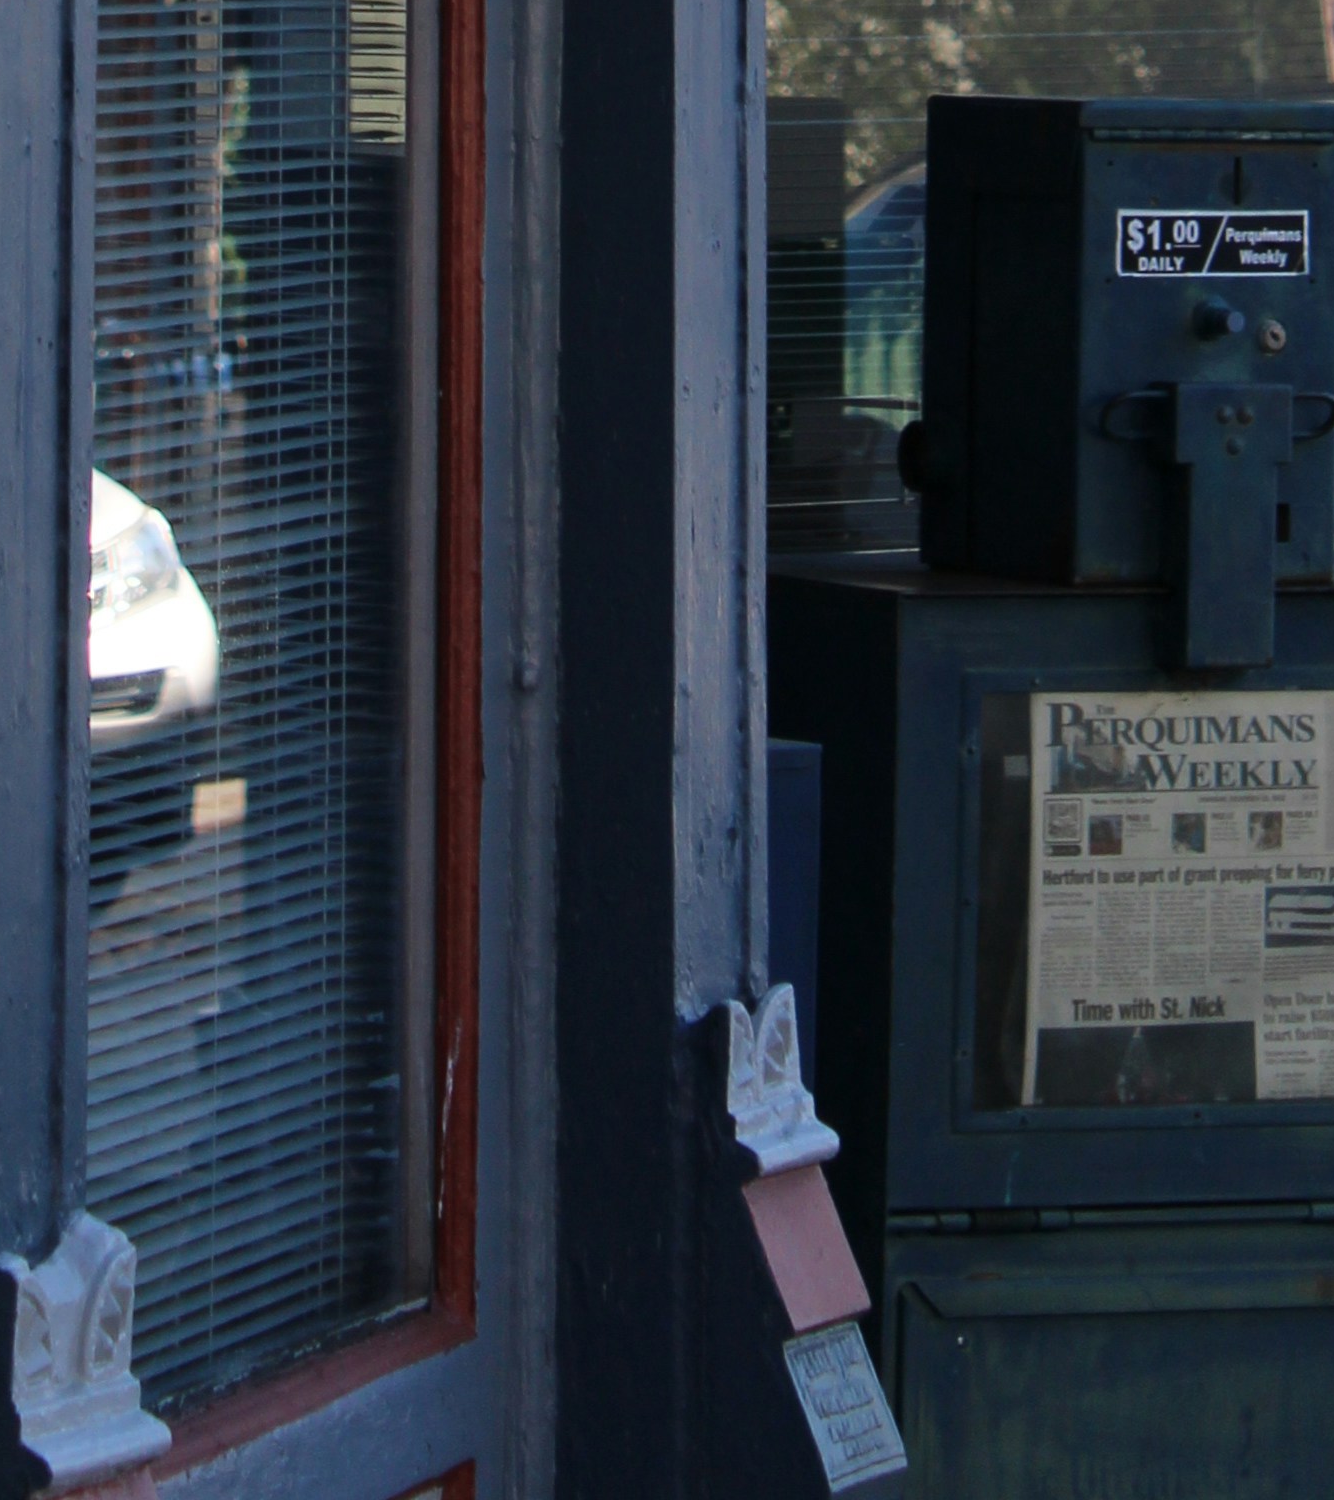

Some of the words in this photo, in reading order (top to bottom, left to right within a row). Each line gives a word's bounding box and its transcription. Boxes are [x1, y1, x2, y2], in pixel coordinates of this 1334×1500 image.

[1126, 218, 1201, 255] $1.00
[1224, 226, 1303, 246] Perquimans
[1138, 256, 1185, 272] DAILY
[1239, 248, 1288, 268] Weekly
[1046, 701, 1316, 752] PERQUIMANS
[1136, 754, 1319, 790] WEEKLY
[1042, 868, 1096, 886] Hertford
[1097, 870, 1110, 884] to
[1113, 871, 1136, 884] use
[1138, 868, 1165, 887] part
[1168, 866, 1181, 883] of
[1184, 867, 1217, 886] grant
[1219, 866, 1273, 884] prepping
[1275, 863, 1294, 880] for
[1296, 863, 1327, 882] ferry
[1072, 999, 1114, 1022] Time
[1119, 997, 1155, 1020] with
[1160, 996, 1183, 1019] St.
[1189, 995, 1226, 1018] Nick
